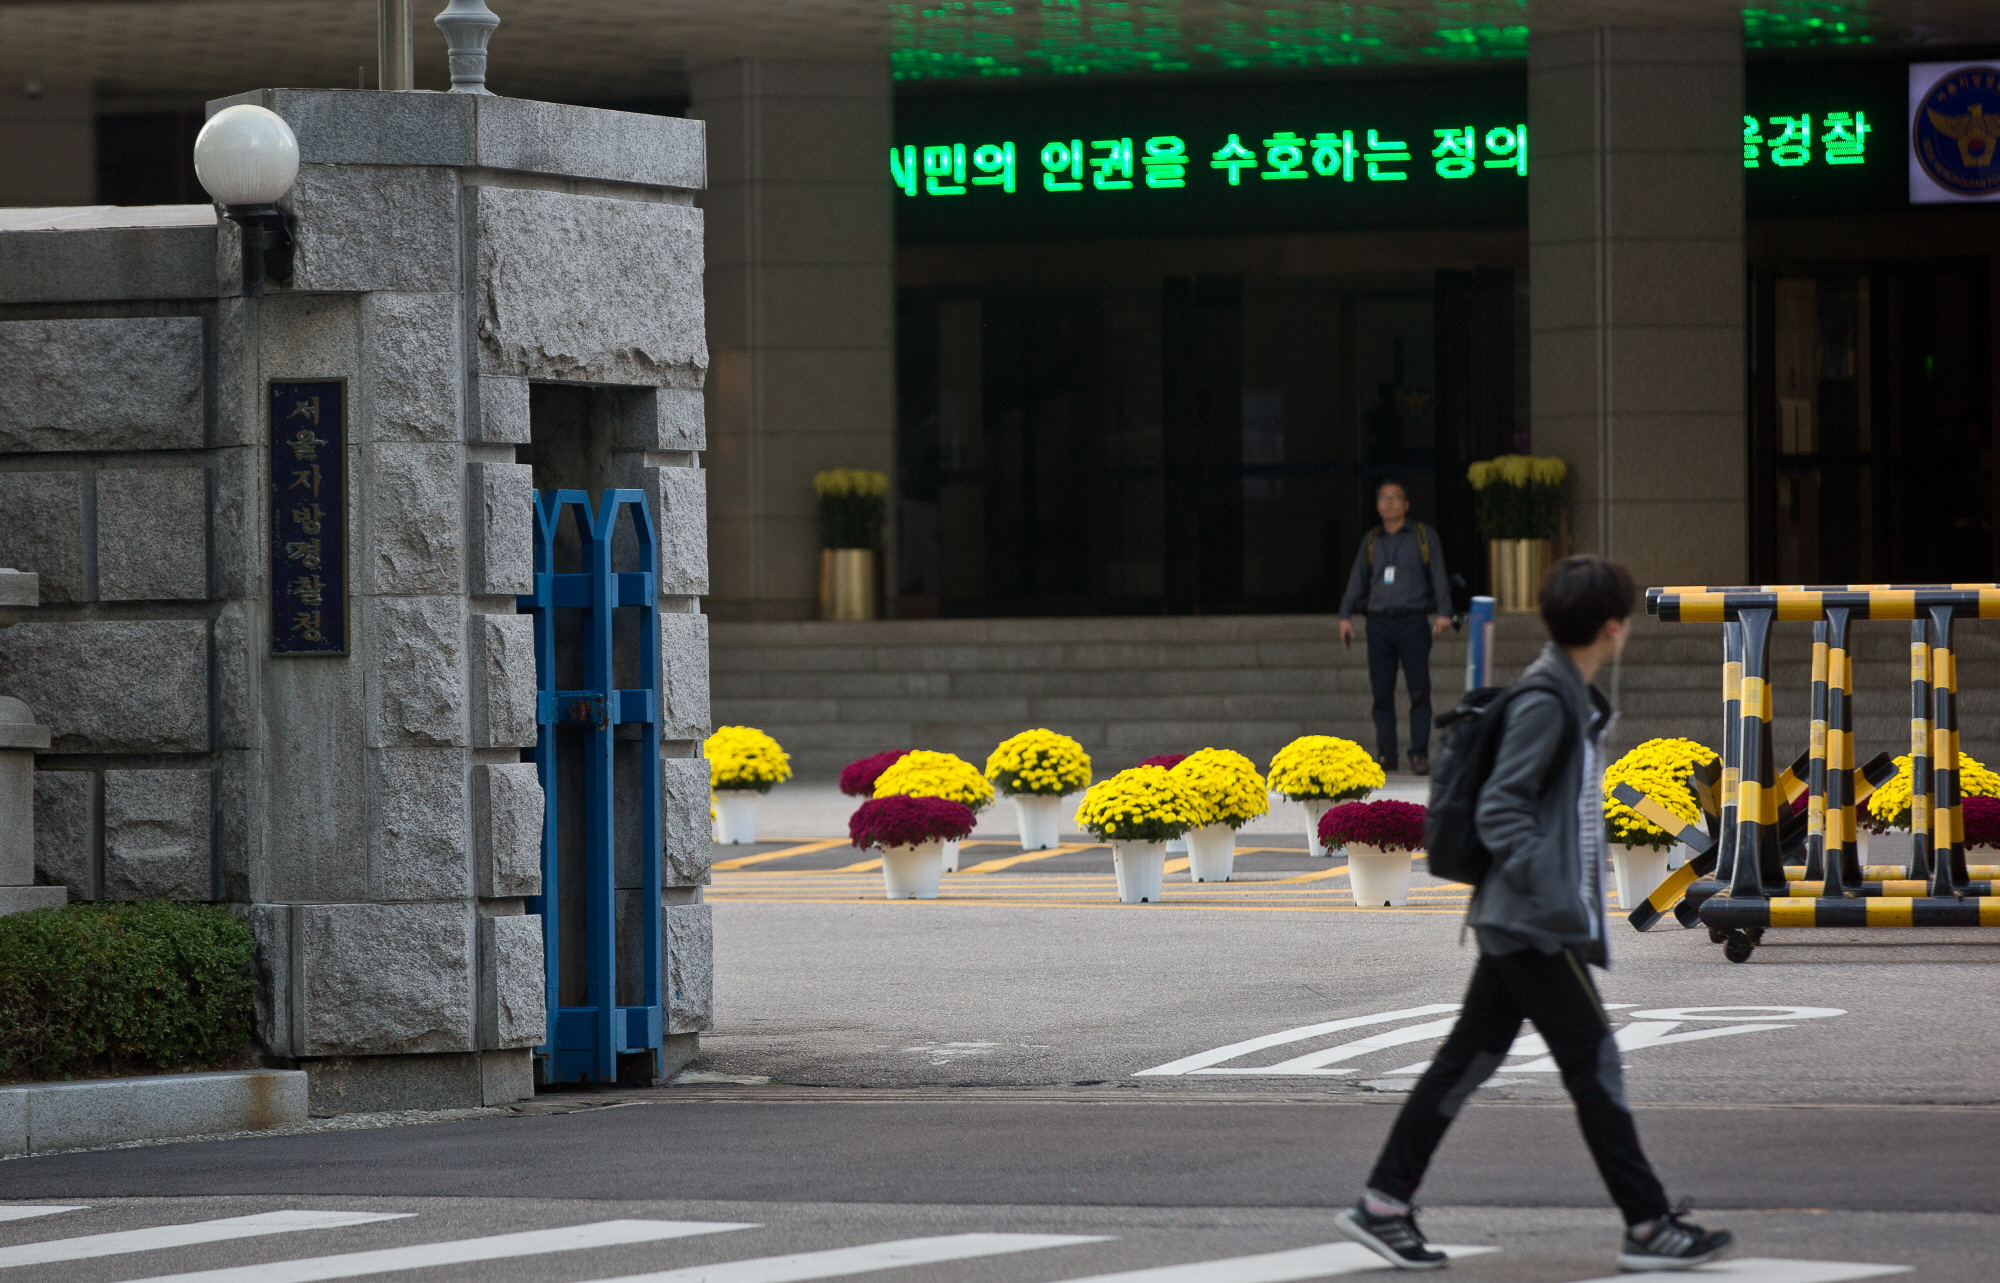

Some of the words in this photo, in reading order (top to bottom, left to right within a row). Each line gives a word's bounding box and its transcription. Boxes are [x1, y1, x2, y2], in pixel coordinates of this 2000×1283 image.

[1040, 136, 1189, 191] 인권을
[1209, 129, 1411, 185] 수호하는
[1431, 123, 1527, 178] 정의
[286, 395, 328, 642] 서울지방경찰청
